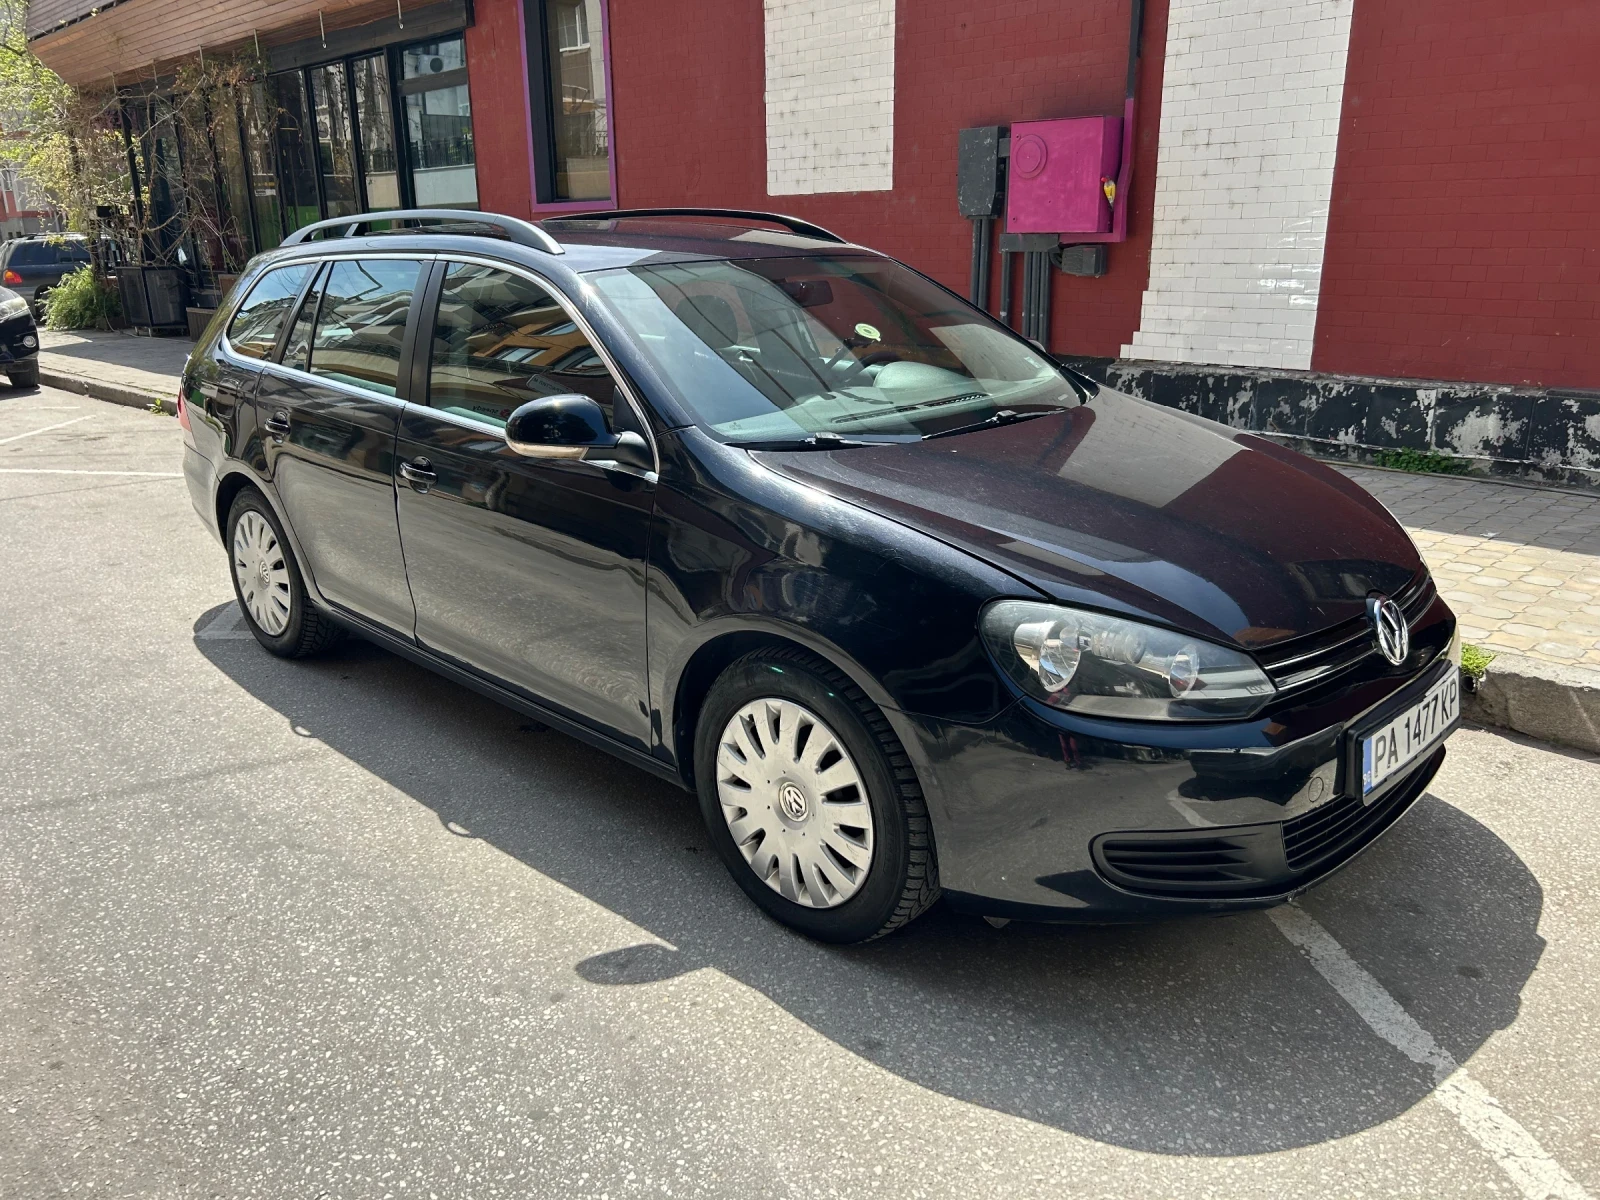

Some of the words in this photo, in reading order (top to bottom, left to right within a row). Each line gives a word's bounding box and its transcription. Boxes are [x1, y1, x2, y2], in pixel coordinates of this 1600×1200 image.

[1374, 727, 1399, 778] PA
[1404, 693, 1439, 755] 1477
[1441, 678, 1457, 725] KP
